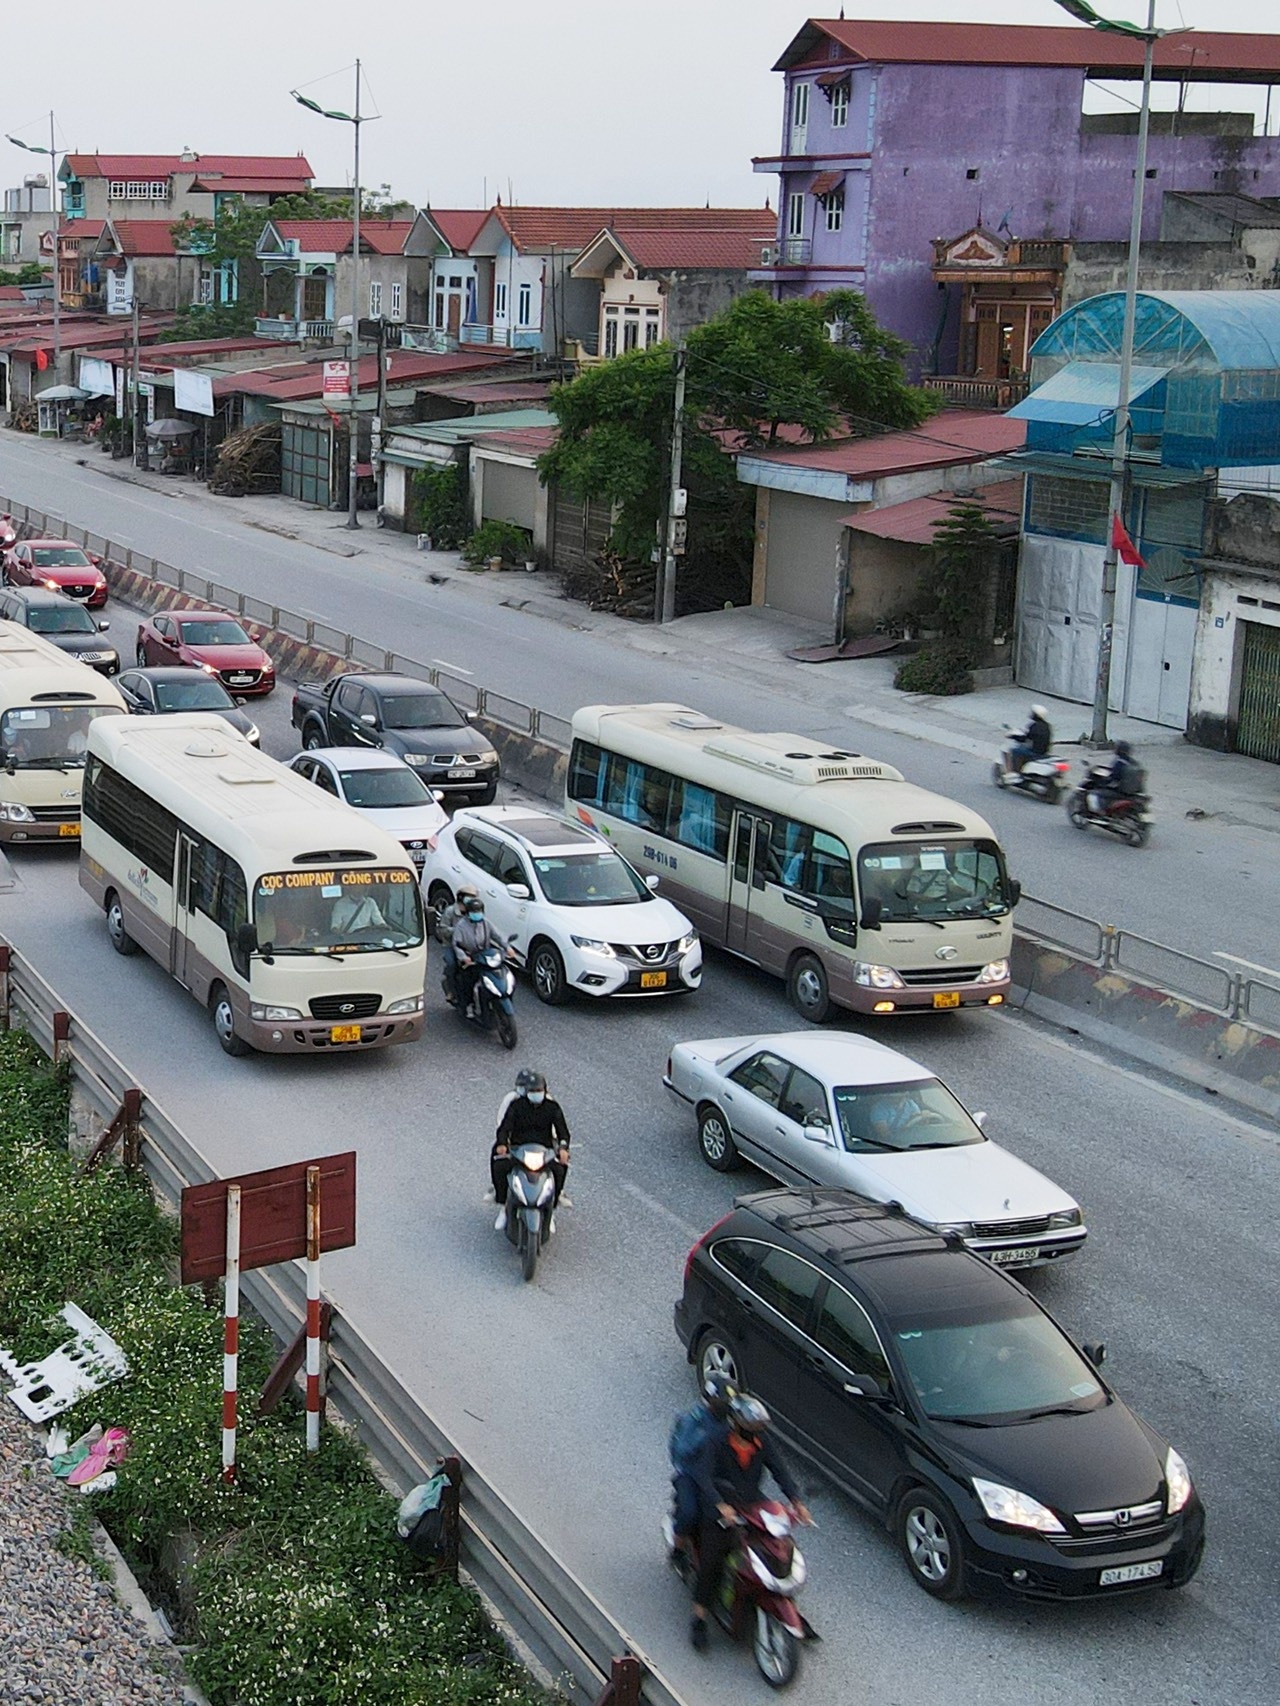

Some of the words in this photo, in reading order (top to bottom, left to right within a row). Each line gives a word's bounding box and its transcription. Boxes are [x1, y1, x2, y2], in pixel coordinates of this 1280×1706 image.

[285, 872, 335, 888] COMPANY
[341, 870, 372, 885] CÔNG
[373, 872, 387, 883] TY
